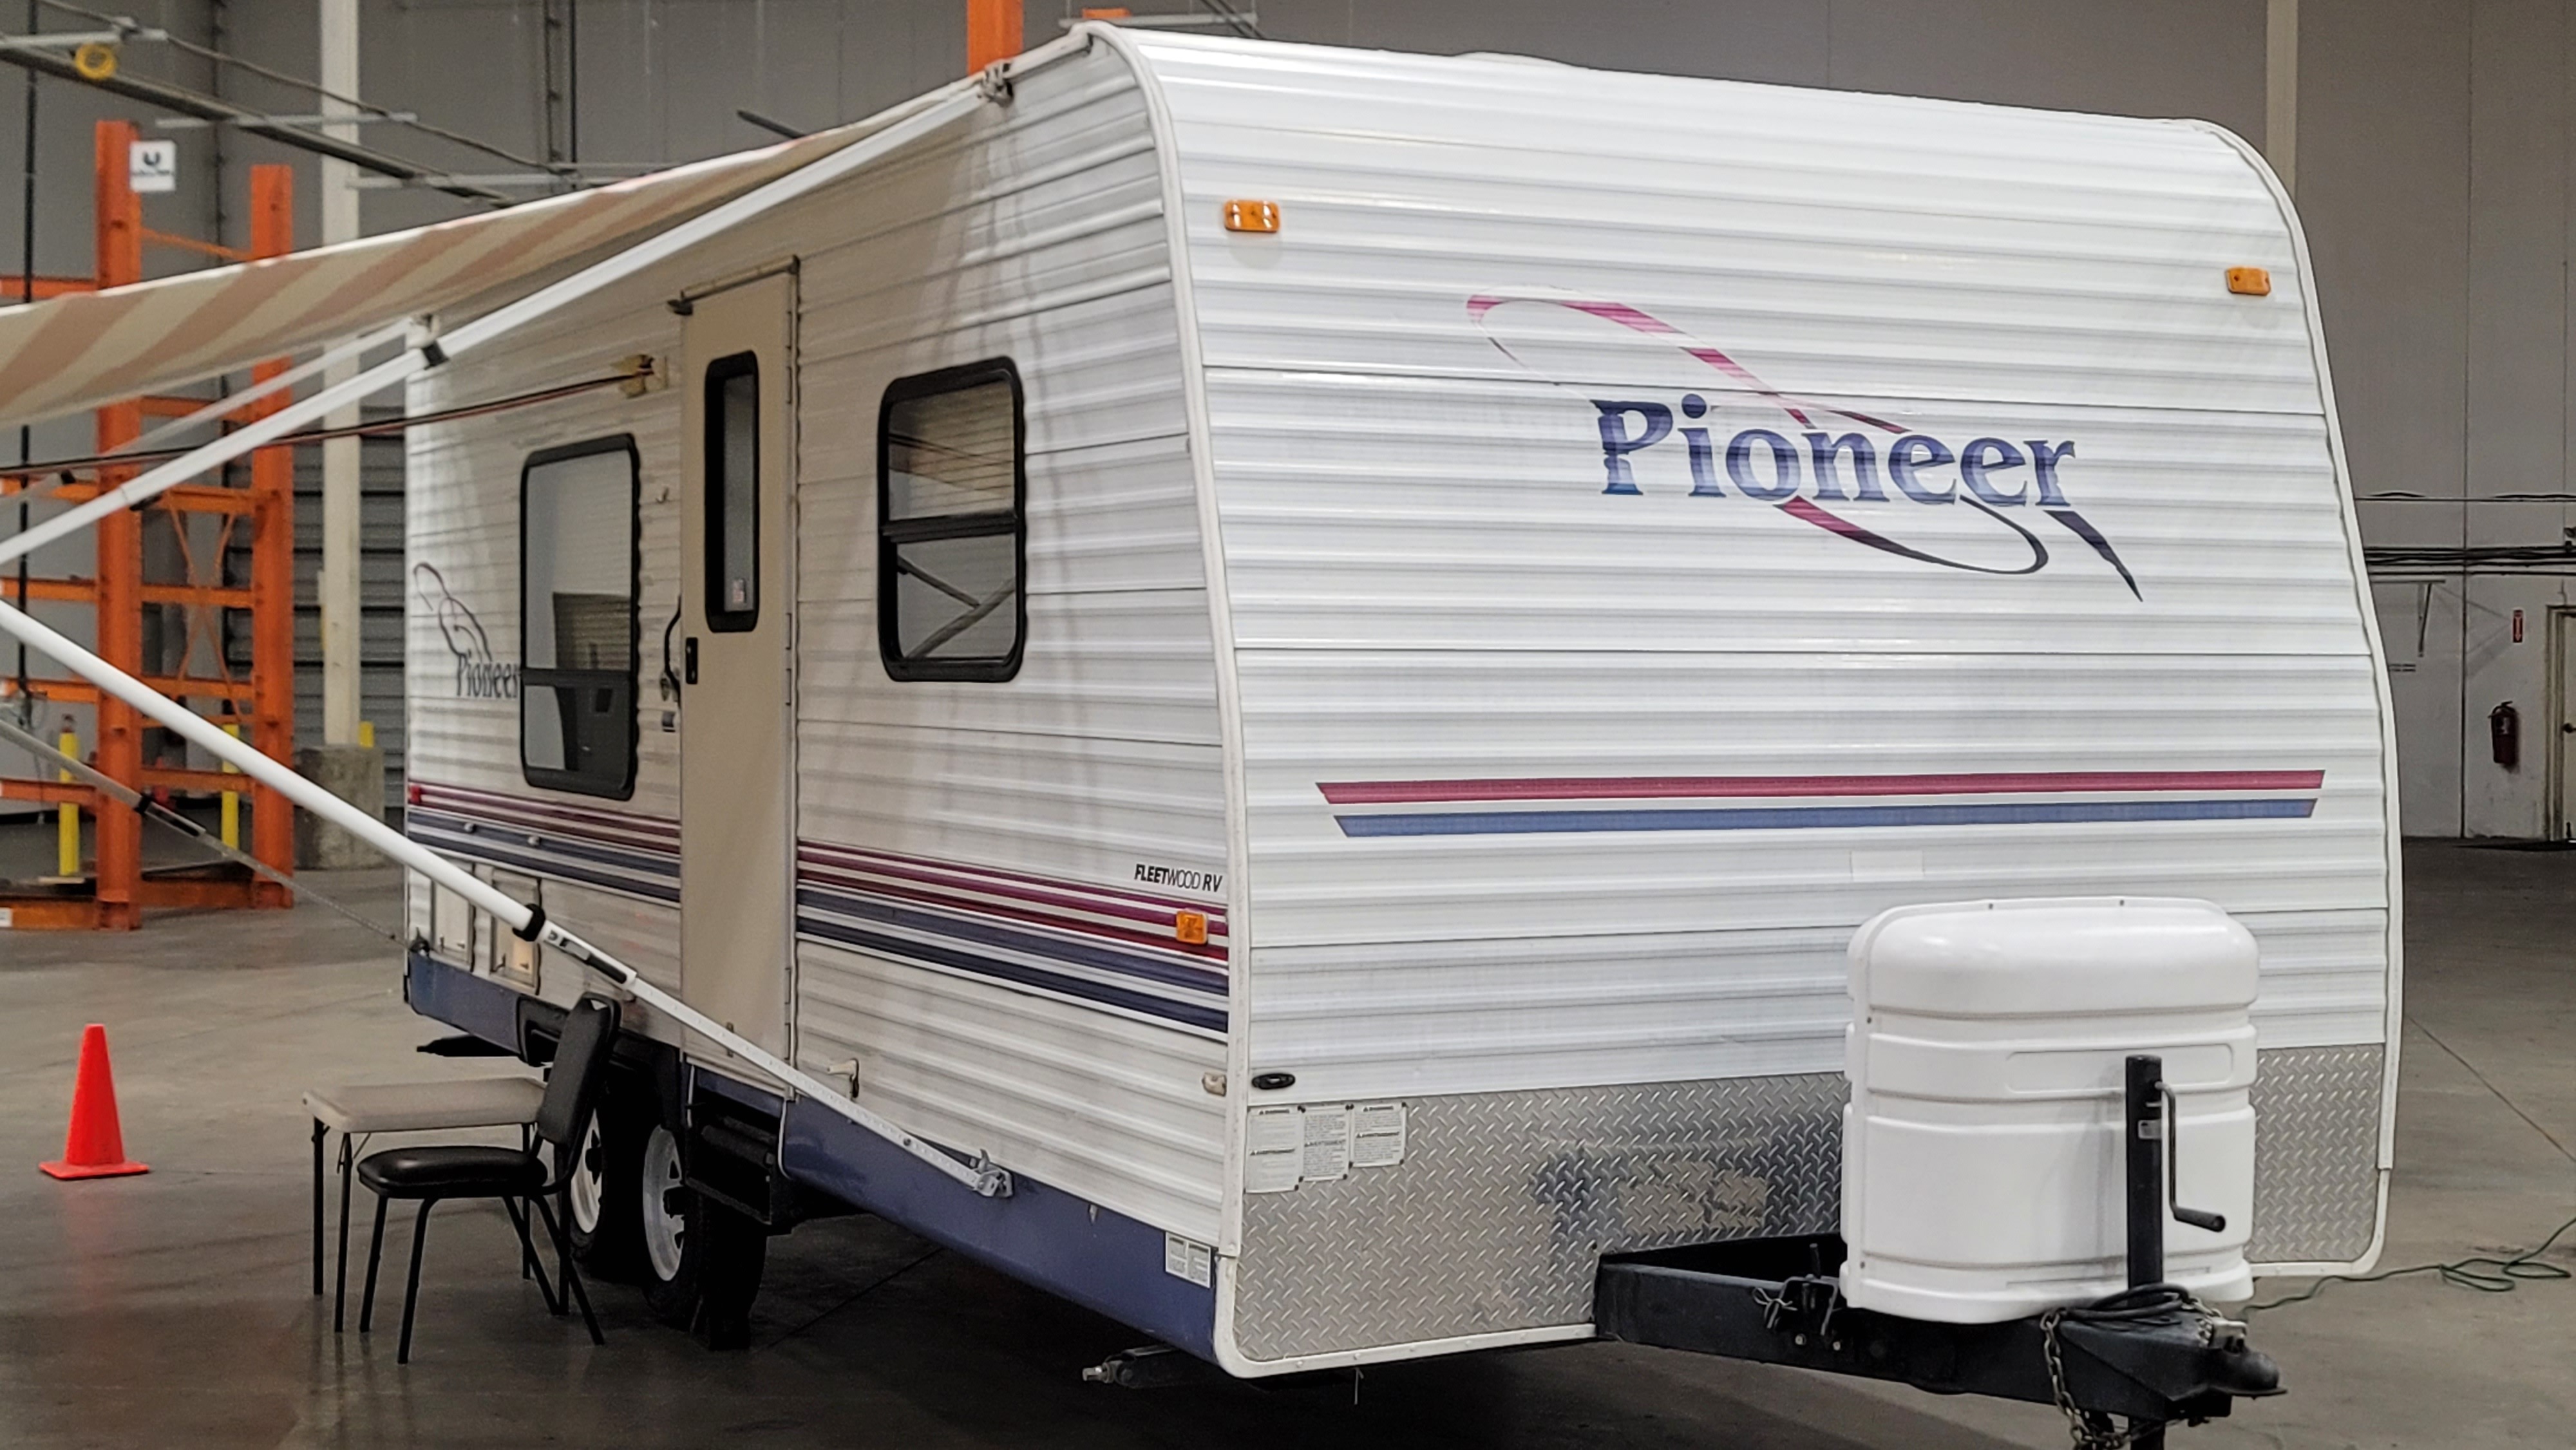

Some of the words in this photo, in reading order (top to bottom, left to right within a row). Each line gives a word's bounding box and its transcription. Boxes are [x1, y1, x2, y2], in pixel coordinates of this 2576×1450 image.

[1589, 393, 2076, 508] Pioneer
[1134, 863, 1201, 889] FLEETWOOD
[1202, 873, 1223, 892] RV
